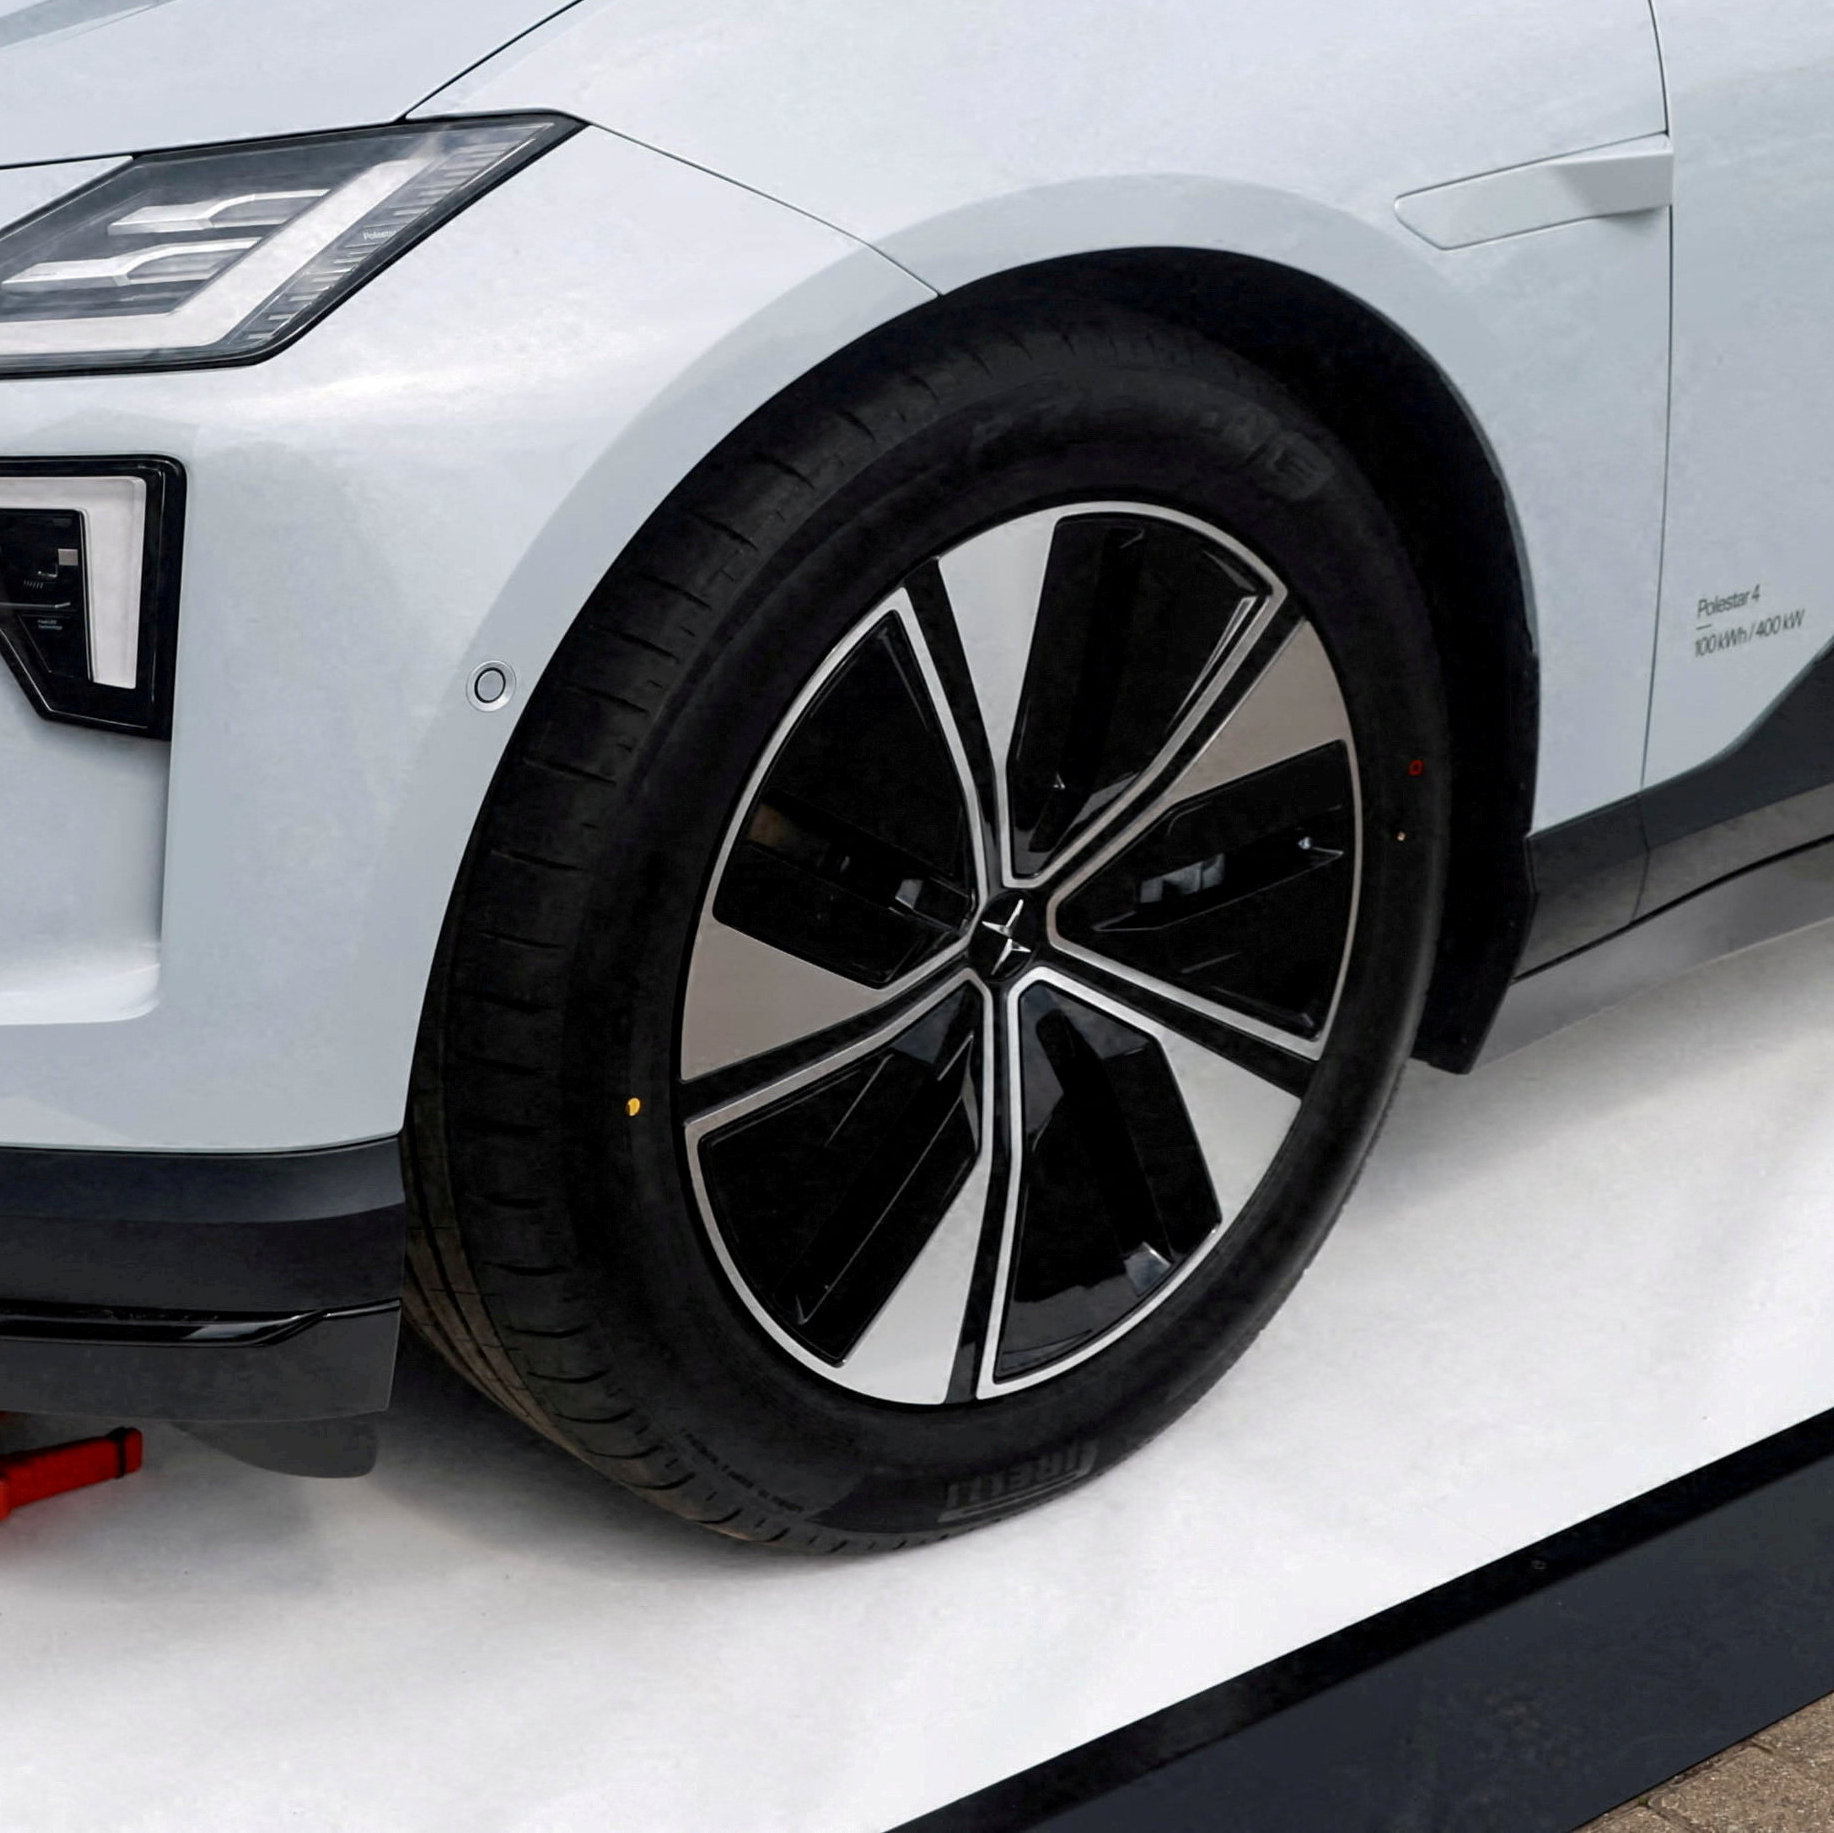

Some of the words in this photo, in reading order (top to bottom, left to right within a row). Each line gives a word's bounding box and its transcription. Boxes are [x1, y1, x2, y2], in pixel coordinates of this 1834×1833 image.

[1697, 592, 1750, 618] Polestar
[1752, 584, 1761, 602] 4
[1695, 634, 1717, 657] 100
[1755, 616, 1782, 637] 400
[1782, 609, 1806, 629] kW
